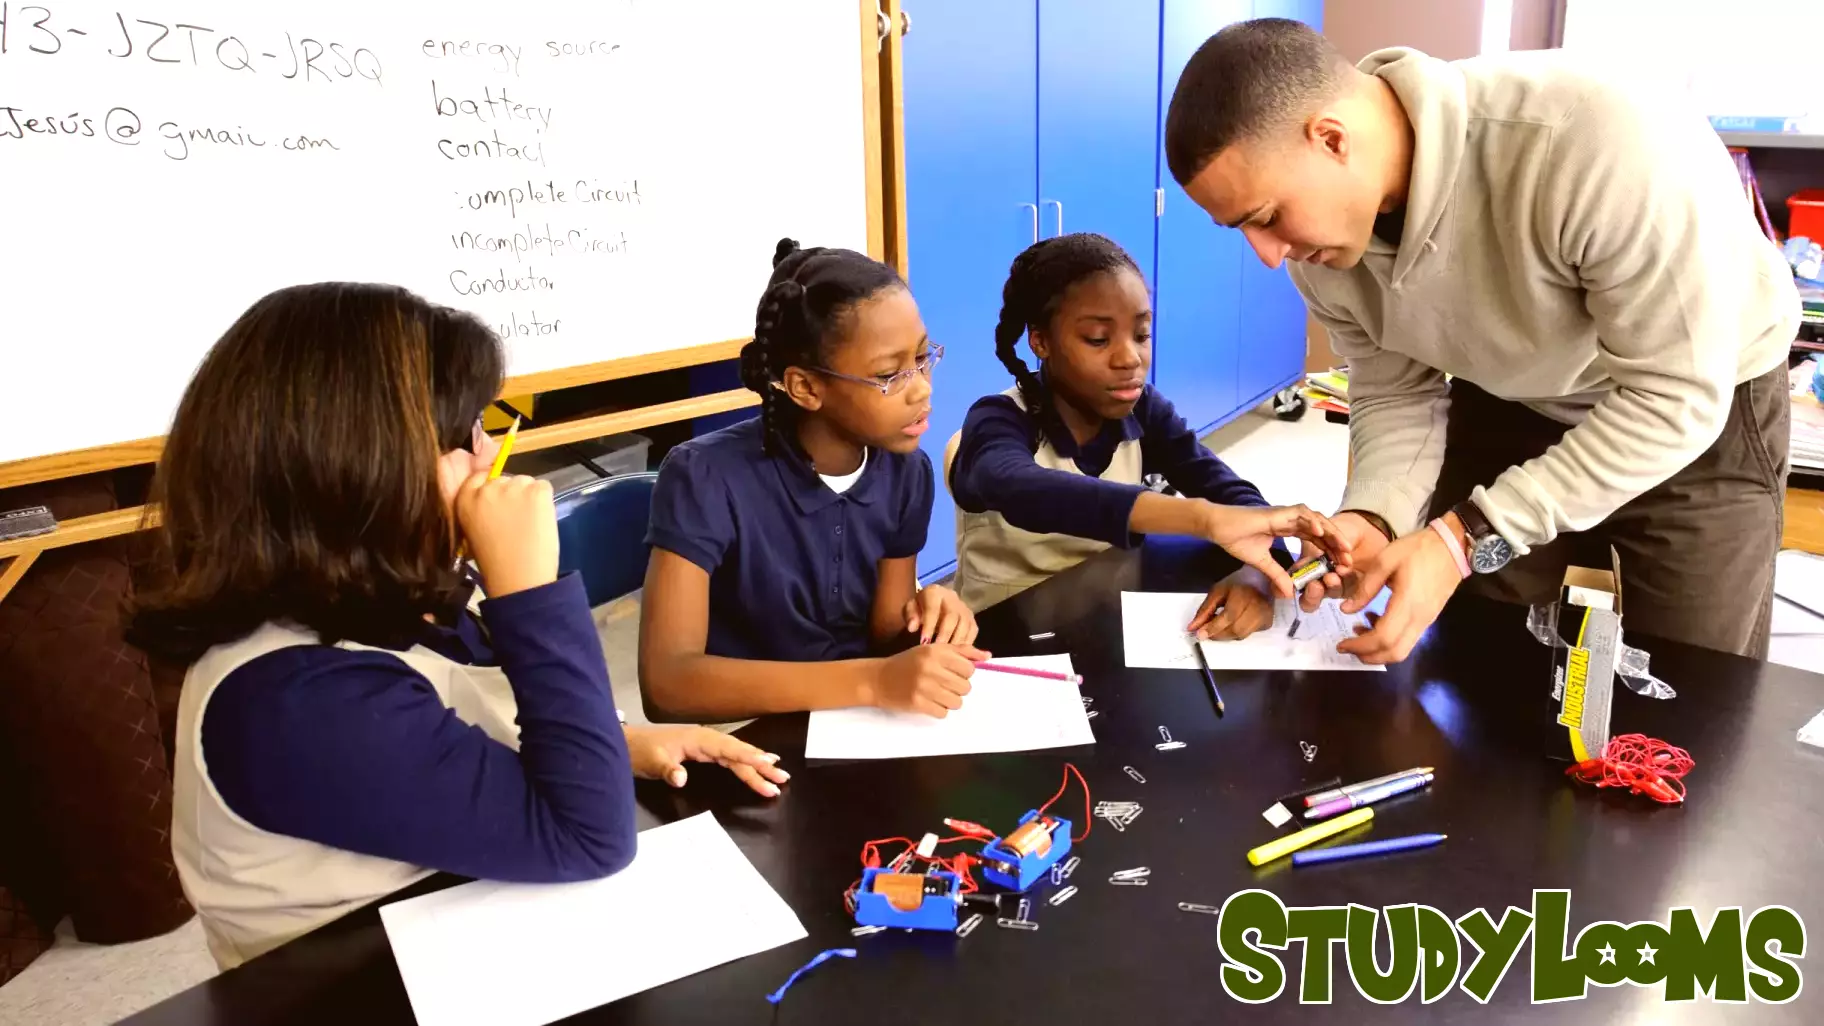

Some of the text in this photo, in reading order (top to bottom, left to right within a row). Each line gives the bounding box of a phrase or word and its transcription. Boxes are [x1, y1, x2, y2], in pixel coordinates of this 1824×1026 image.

[422, 39, 522, 78] energy
[431, 79, 552, 132] battery
[454, 178, 642, 219] omplete Circuit
[451, 223, 629, 264] incomplete Circuit
[500, 310, 562, 339] ulator
[1558, 647, 1591, 731] INDUSTRIAL
